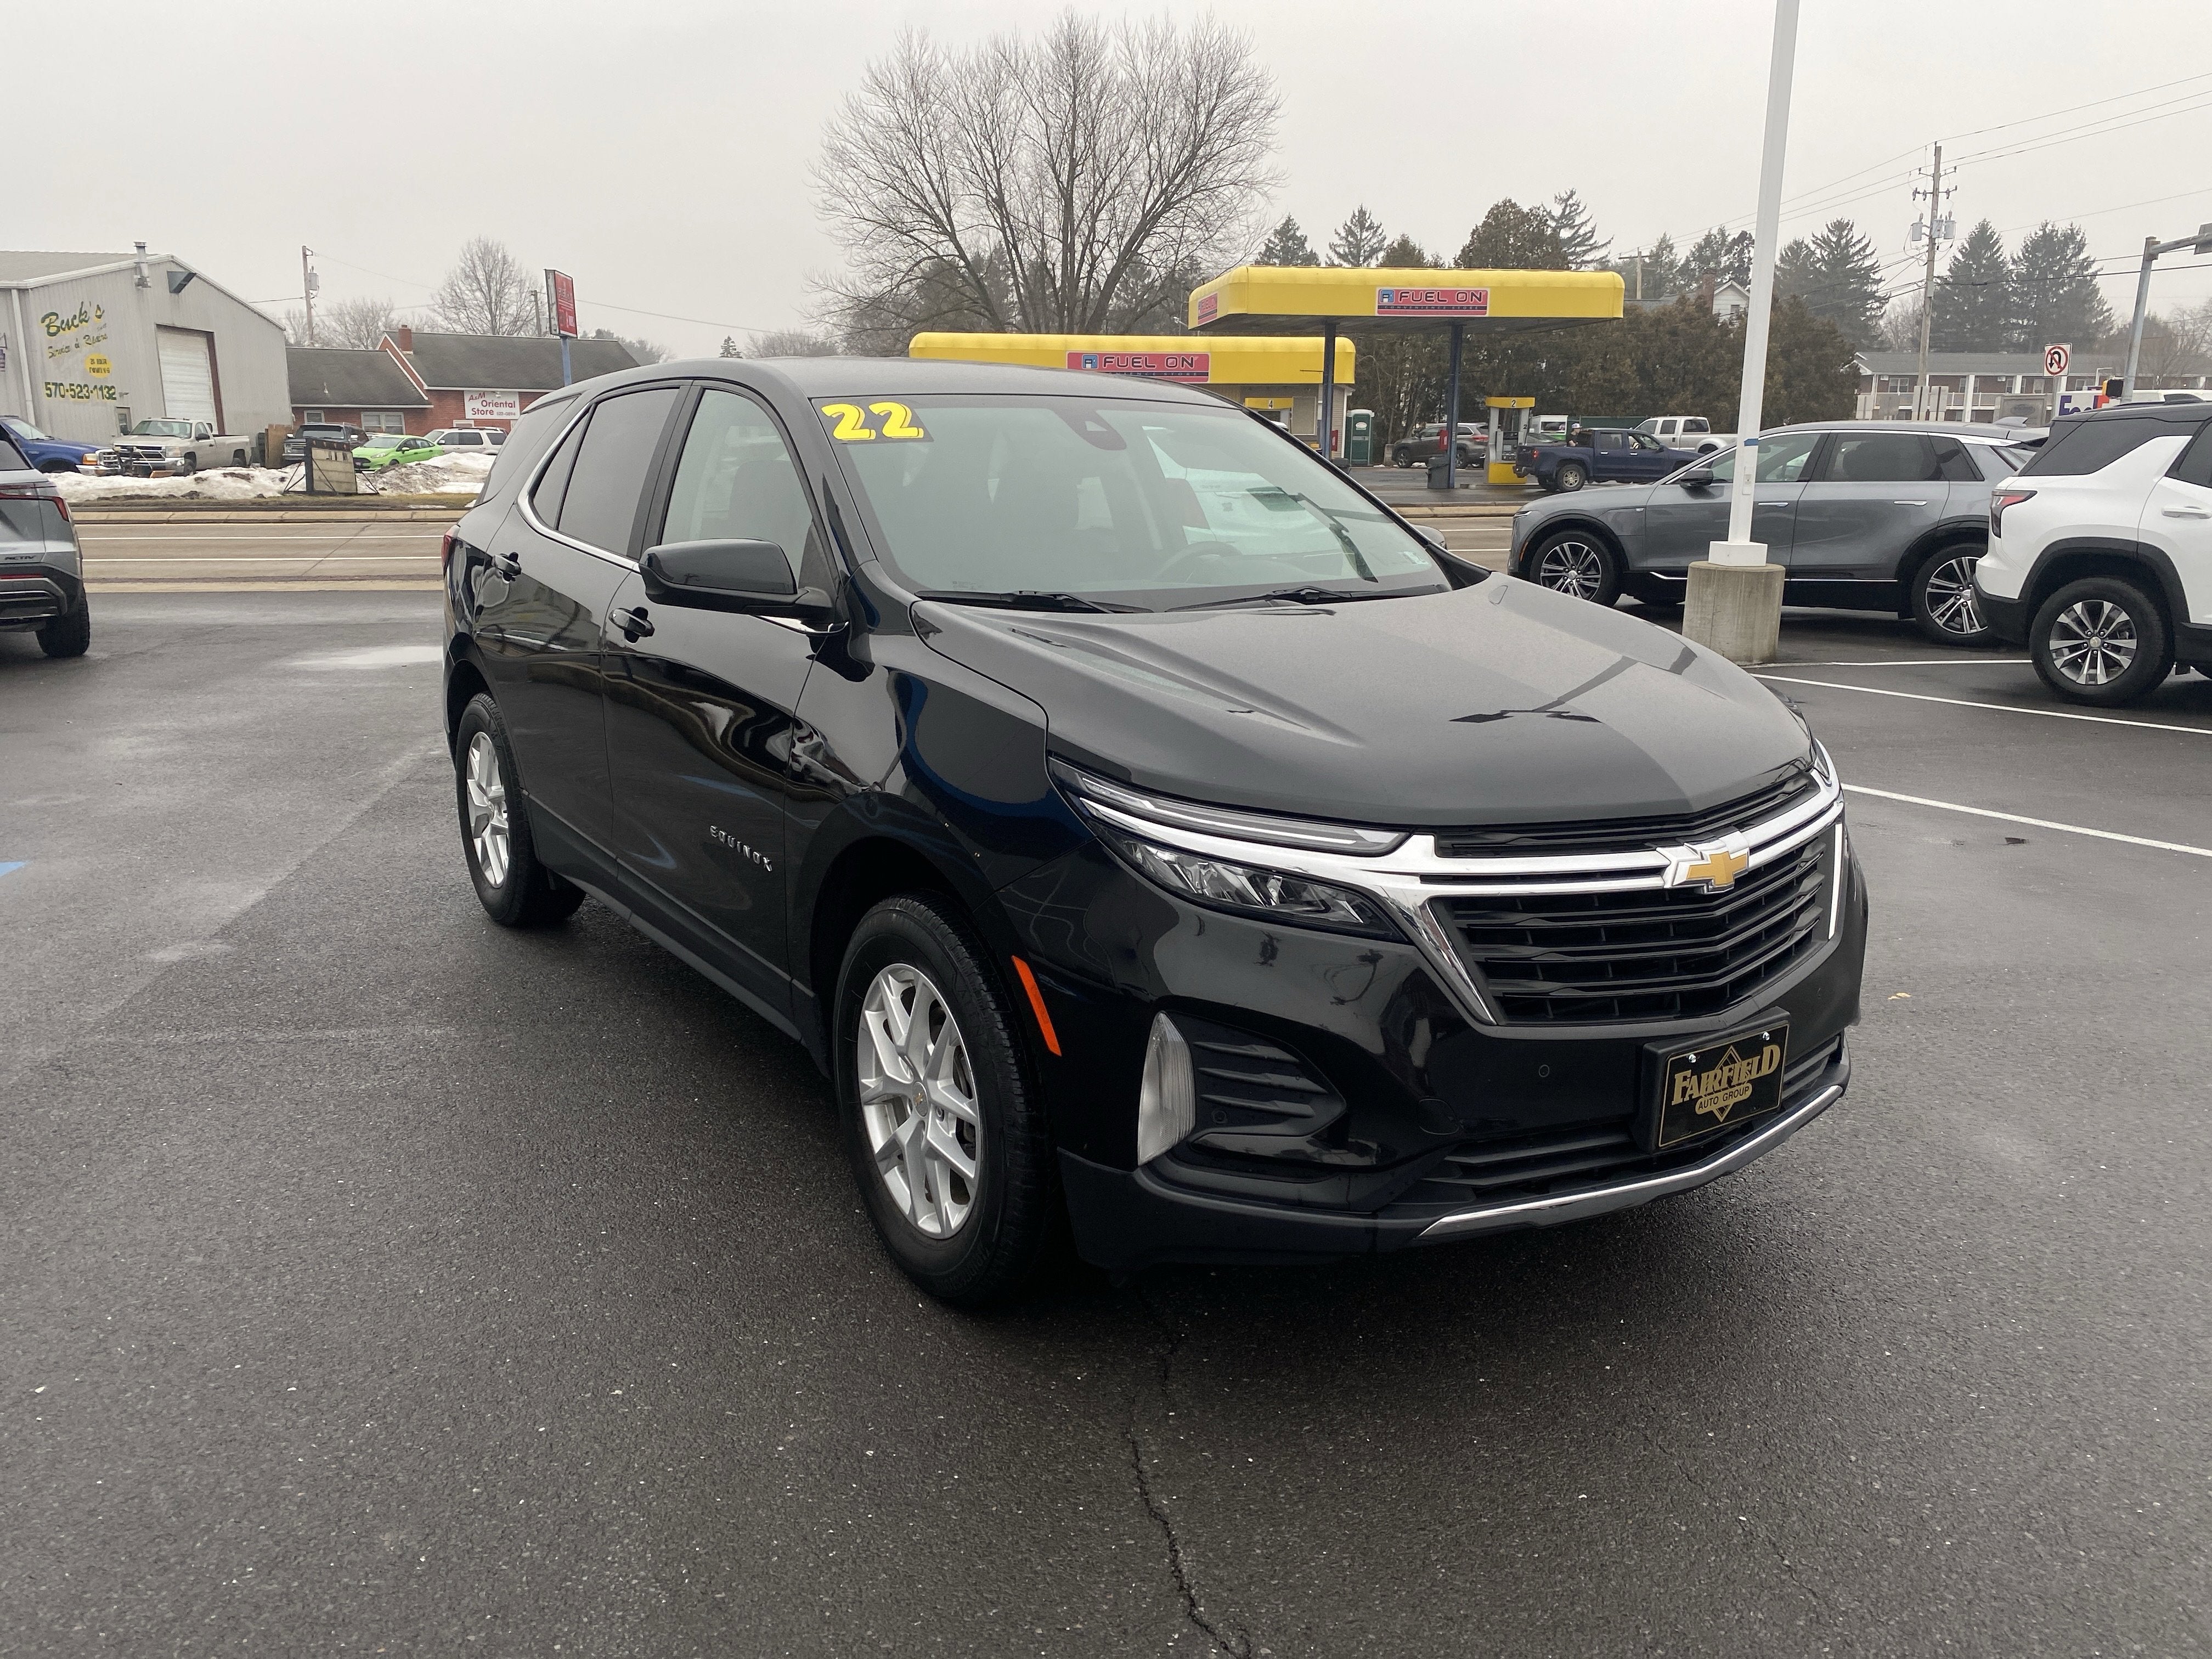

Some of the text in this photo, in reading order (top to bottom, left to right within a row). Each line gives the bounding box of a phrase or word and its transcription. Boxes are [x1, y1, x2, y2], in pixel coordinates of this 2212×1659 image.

[1400, 291, 1482, 302] FUEL ON
[41, 301, 105, 336] Buck's
[1103, 356, 1194, 368] FUEL ON
[44, 381, 117, 400] 570-523-1132
[468, 392, 486, 402] A&M
[481, 400, 515, 408] Oriental
[1268, 400, 1273, 409] 4
[1511, 399, 1516, 408] 2
[821, 402, 924, 441] 22
[710, 825, 772, 872] EQUINOX
[1671, 1045, 1781, 1106] FAIRFIELD
[1698, 1086, 1750, 1110] AUTO GROUP
